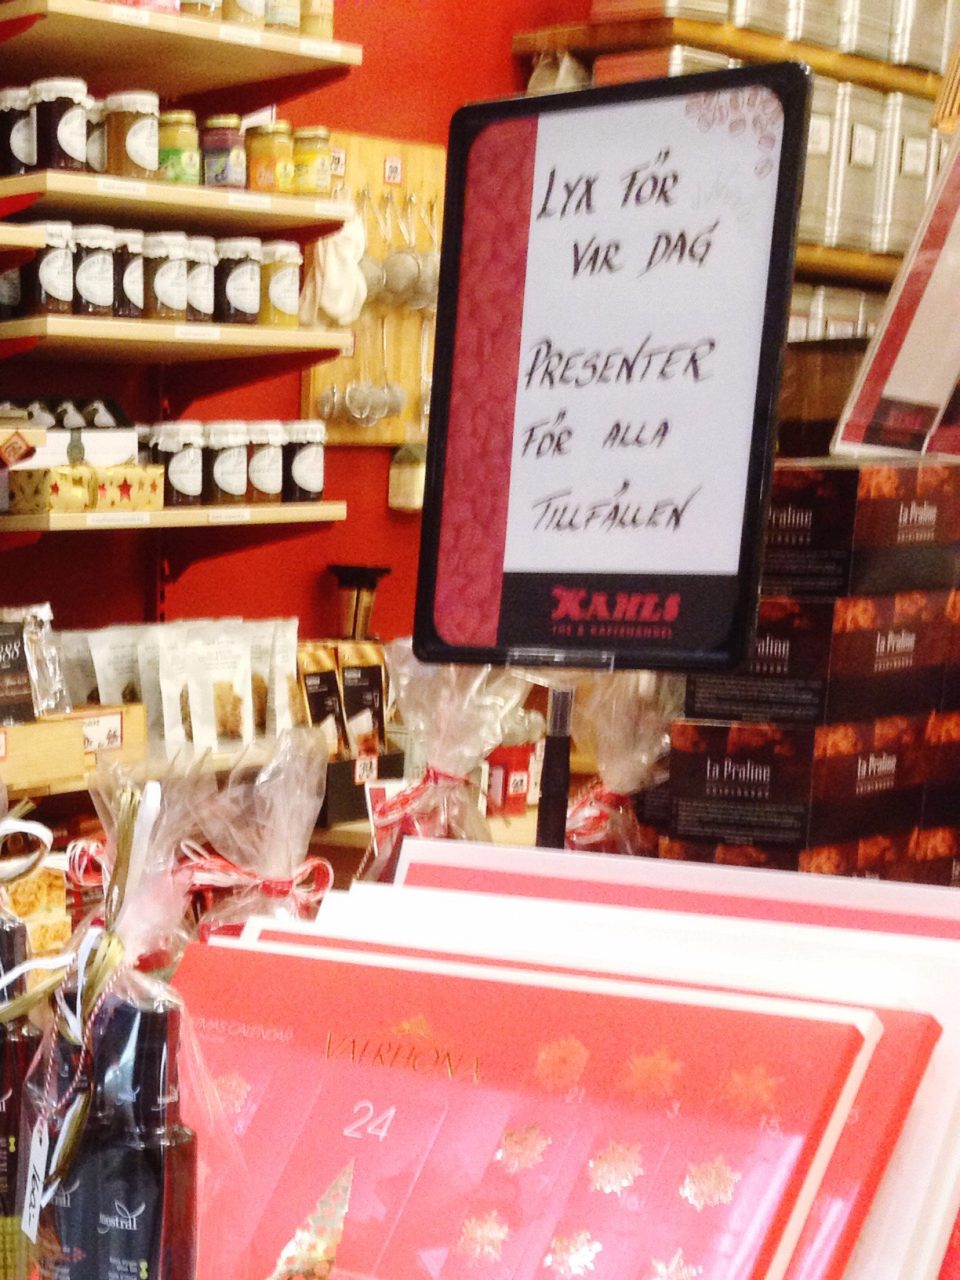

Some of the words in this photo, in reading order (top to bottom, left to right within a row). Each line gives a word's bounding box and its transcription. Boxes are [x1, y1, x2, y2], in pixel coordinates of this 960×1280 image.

[537, 165, 599, 220] LYX
[572, 234, 624, 279] VAR
[637, 217, 721, 278] DAG
[526, 333, 716, 390] PRESENTER
[522, 408, 573, 459] FÖR
[602, 418, 670, 450] ALLA
[707, 757, 719, 781] la
[724, 757, 771, 783] Praline
[342, 1100, 397, 1142] 24
